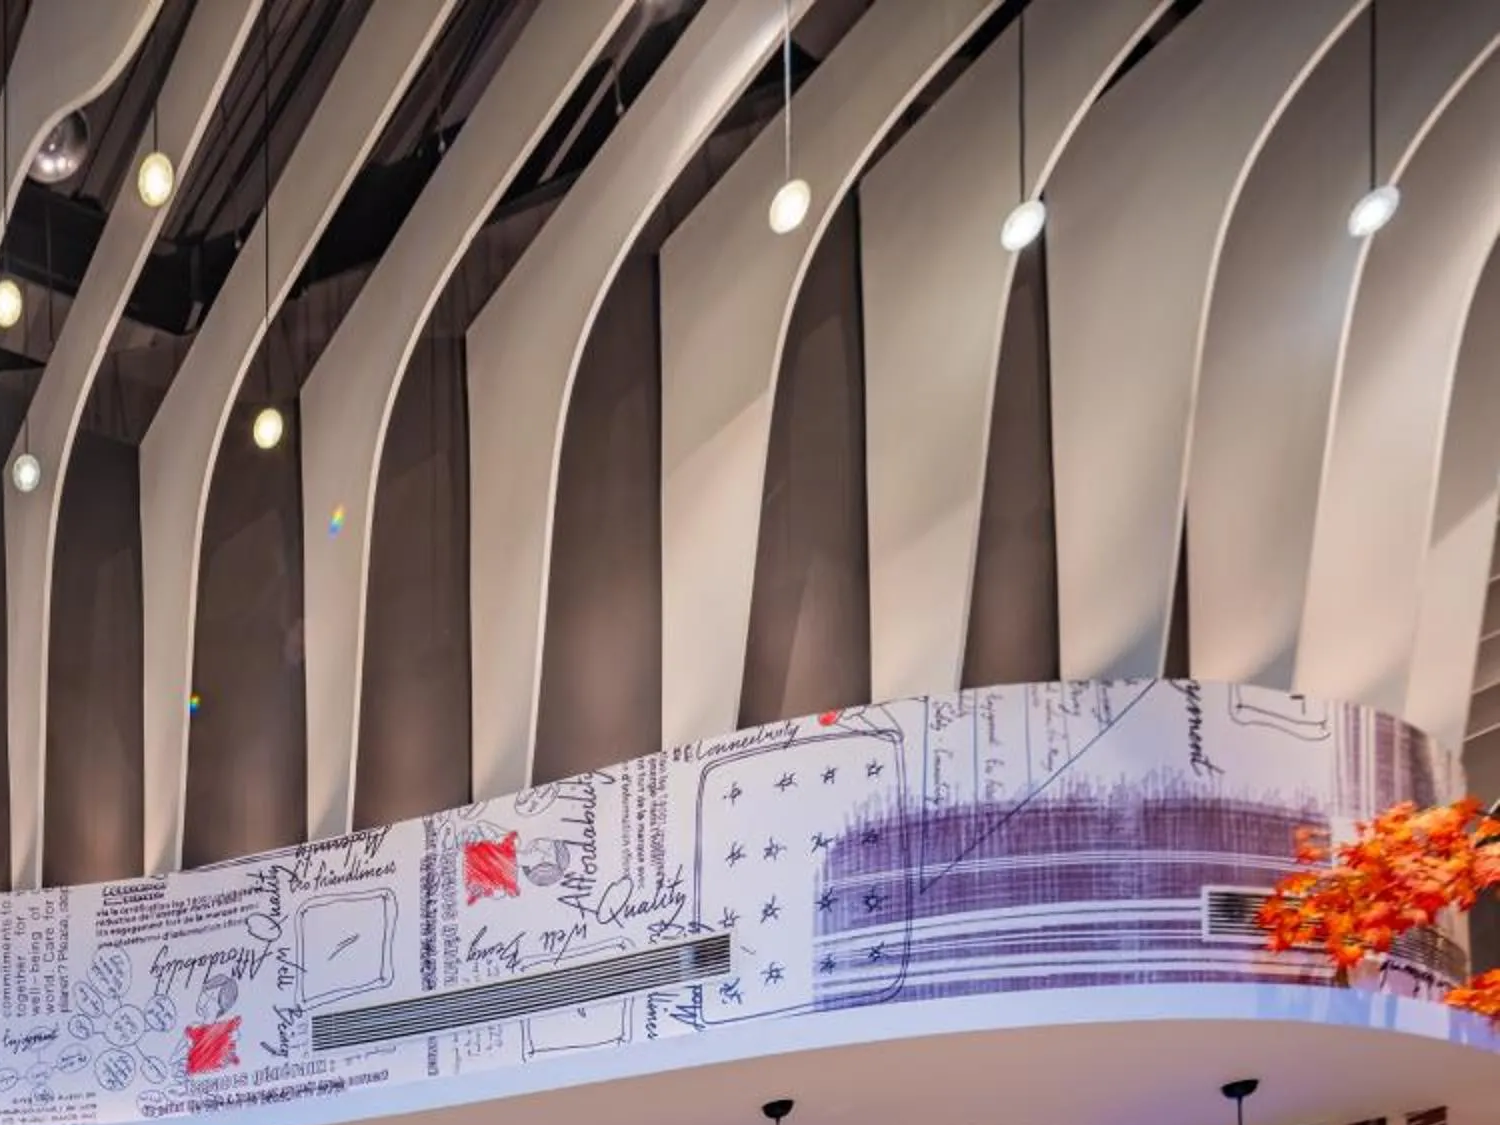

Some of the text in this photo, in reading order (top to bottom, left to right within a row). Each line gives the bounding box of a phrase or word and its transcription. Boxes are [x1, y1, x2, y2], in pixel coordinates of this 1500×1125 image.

[556, 770, 615, 917] Affordability
[29, 906, 40, 919] of
[43, 900, 54, 918] for
[245, 864, 289, 943] Quality
[596, 865, 688, 926] Quality
[1, 901, 12, 1017] commitments to
[14, 916, 28, 1017] together for
[43, 927, 54, 963] Care
[150, 942, 278, 996] Affordability
[276, 947, 307, 992] Well
